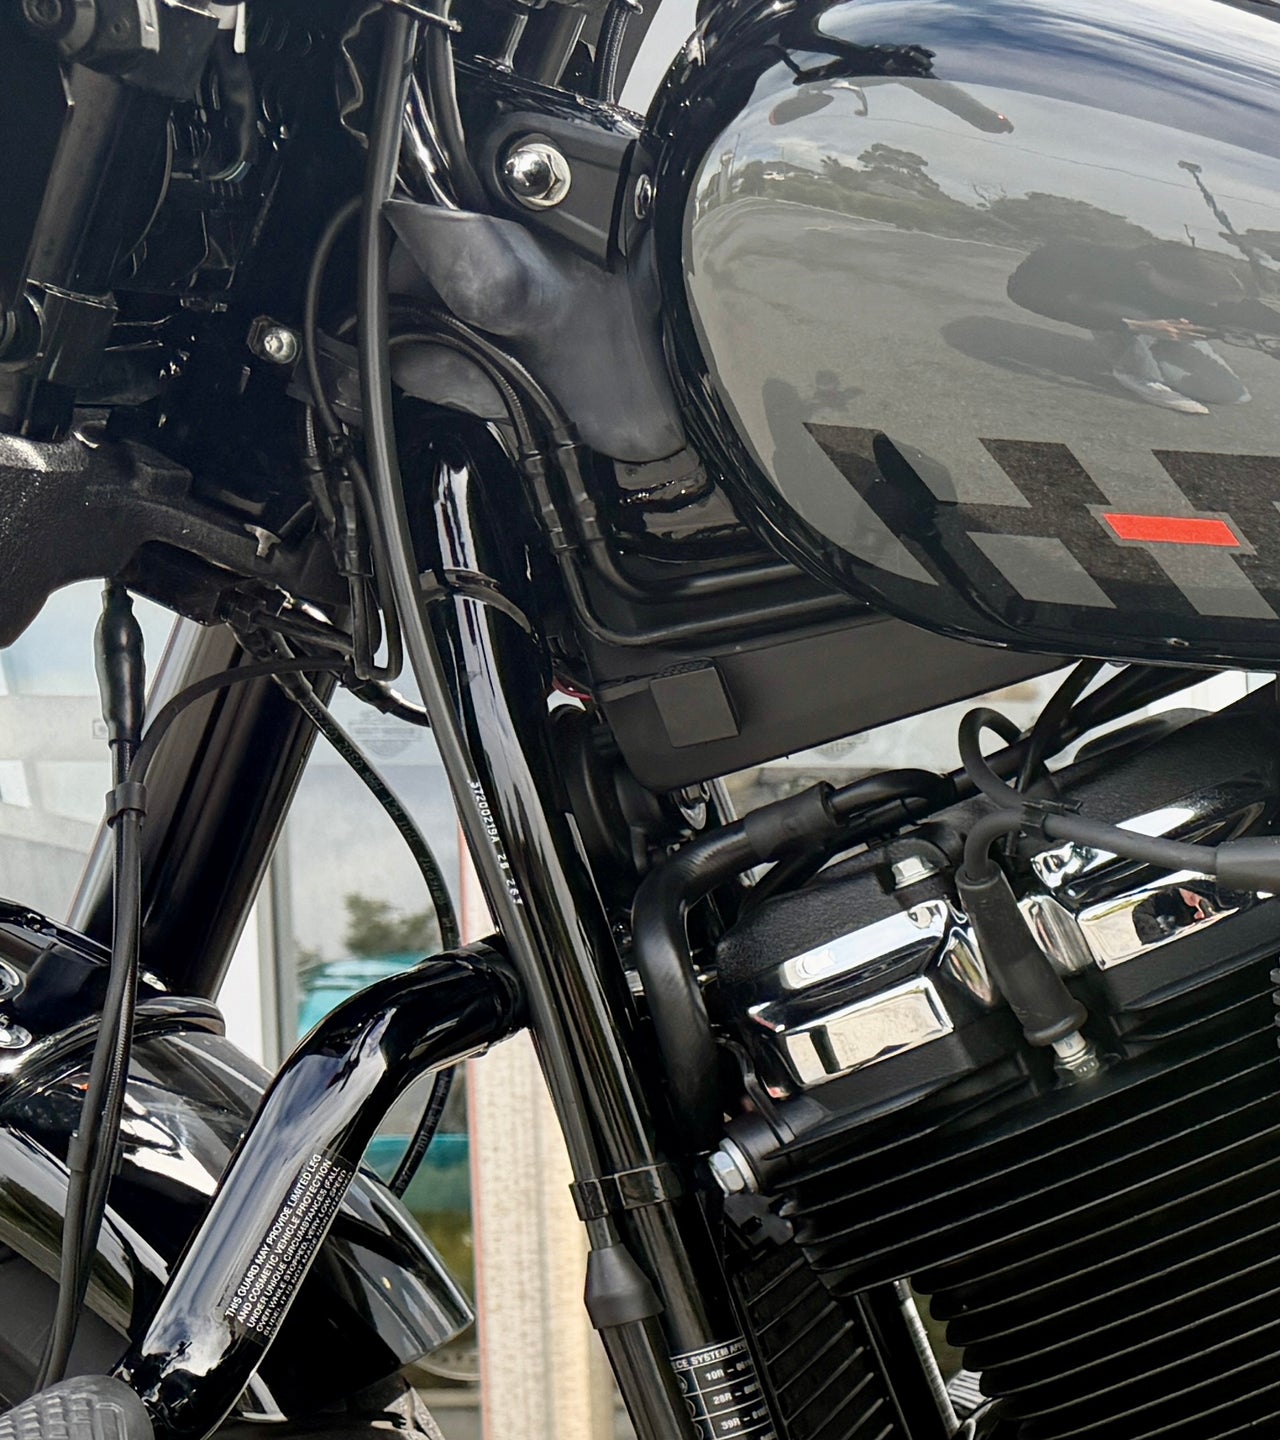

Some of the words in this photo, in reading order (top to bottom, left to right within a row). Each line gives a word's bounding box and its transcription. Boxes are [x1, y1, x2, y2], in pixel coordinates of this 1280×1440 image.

[225, 1296, 241, 1317] THIS
[237, 1264, 259, 1295] GUARD
[255, 1245, 270, 1264] MAY
[266, 1206, 292, 1244] PROVIDE
[287, 1172, 311, 1206] LIMITED
[307, 1154, 321, 1171] LEG
[236, 1302, 252, 1322] AND
[249, 1254, 279, 1300] COSMETIC
[274, 1216, 300, 1253] VEHICLE
[296, 1159, 331, 1215] PROTECTION
[247, 1296, 268, 1327] UNDER
[264, 1262, 287, 1295] UNIQUE
[283, 1189, 327, 1260] CIRCUMSTANCES
[256, 1308, 272, 1331] OVER
[318, 1198, 331, 1216] LOW
[691, 1348, 729, 1366] SYSTEM
